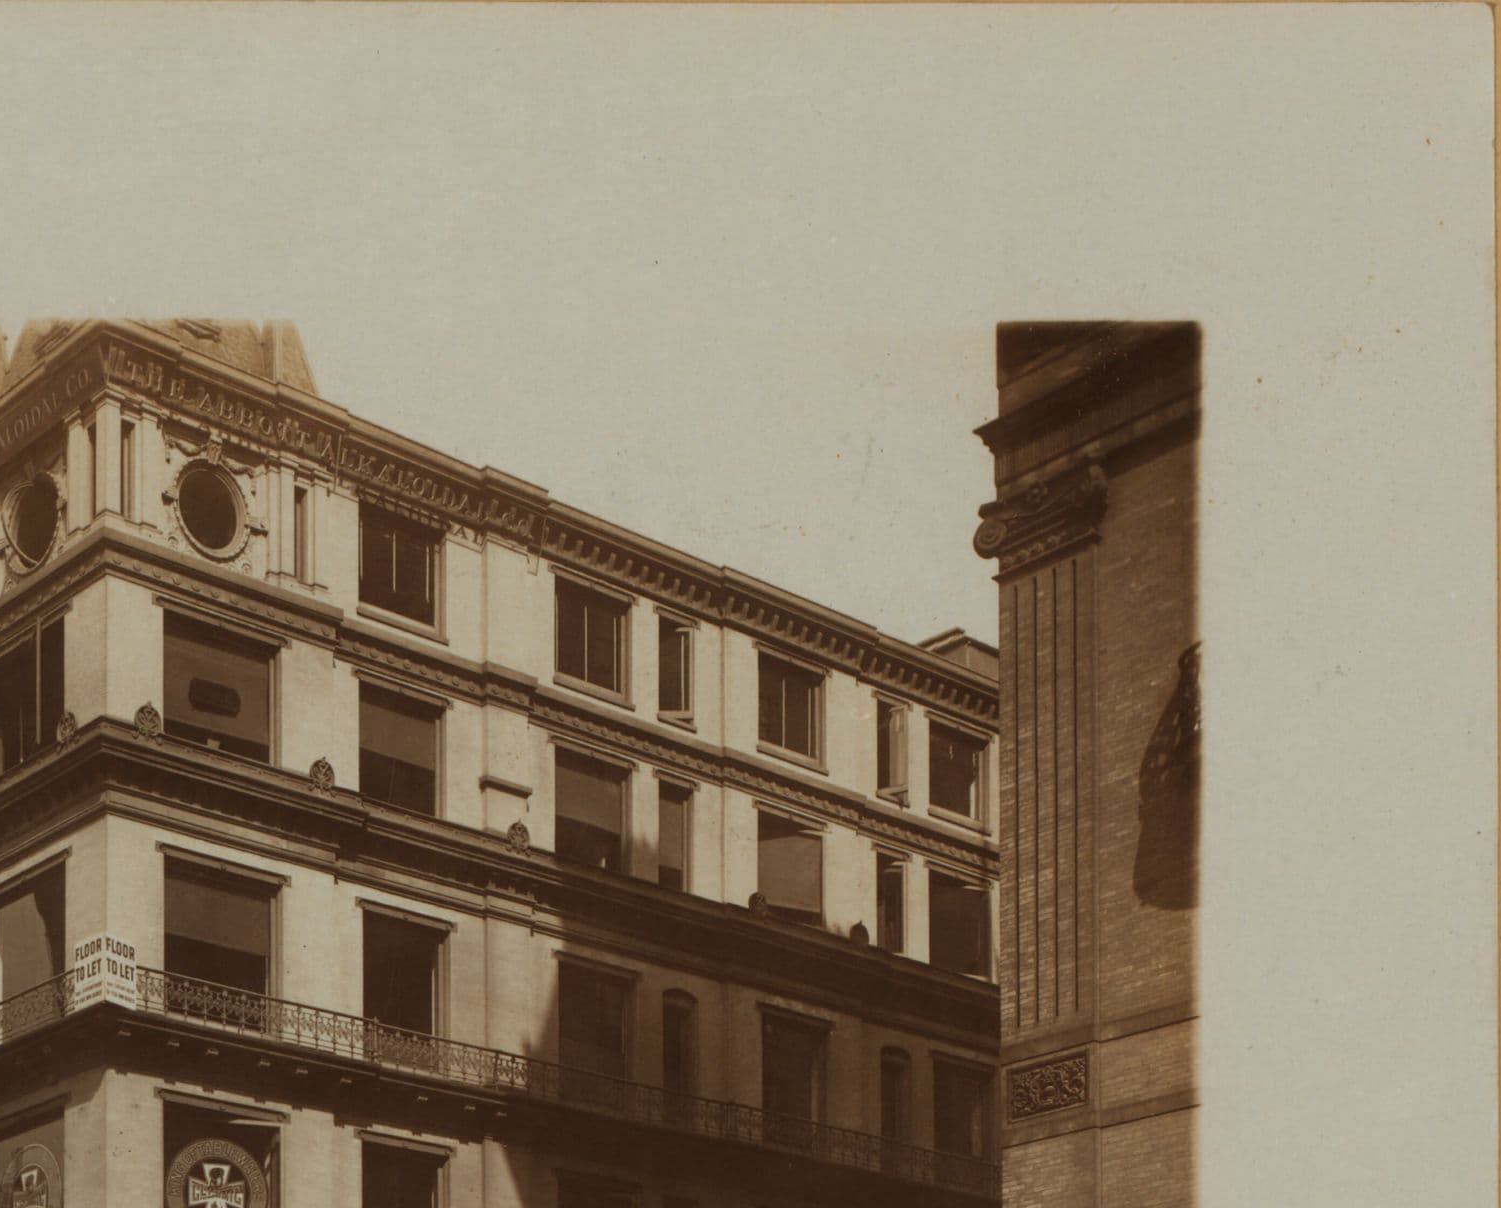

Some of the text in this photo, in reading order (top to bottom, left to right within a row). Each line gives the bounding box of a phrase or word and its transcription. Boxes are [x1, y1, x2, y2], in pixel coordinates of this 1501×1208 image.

[126, 360, 187, 401] THE
[198, 391, 311, 449] ABBOTT
[319, 435, 489, 522] ALKALOIDAL
[75, 937, 102, 962] FLOOR
[106, 937, 136, 962] FLOOR
[75, 958, 102, 983] TO LET
[106, 958, 135, 982] TO LET
